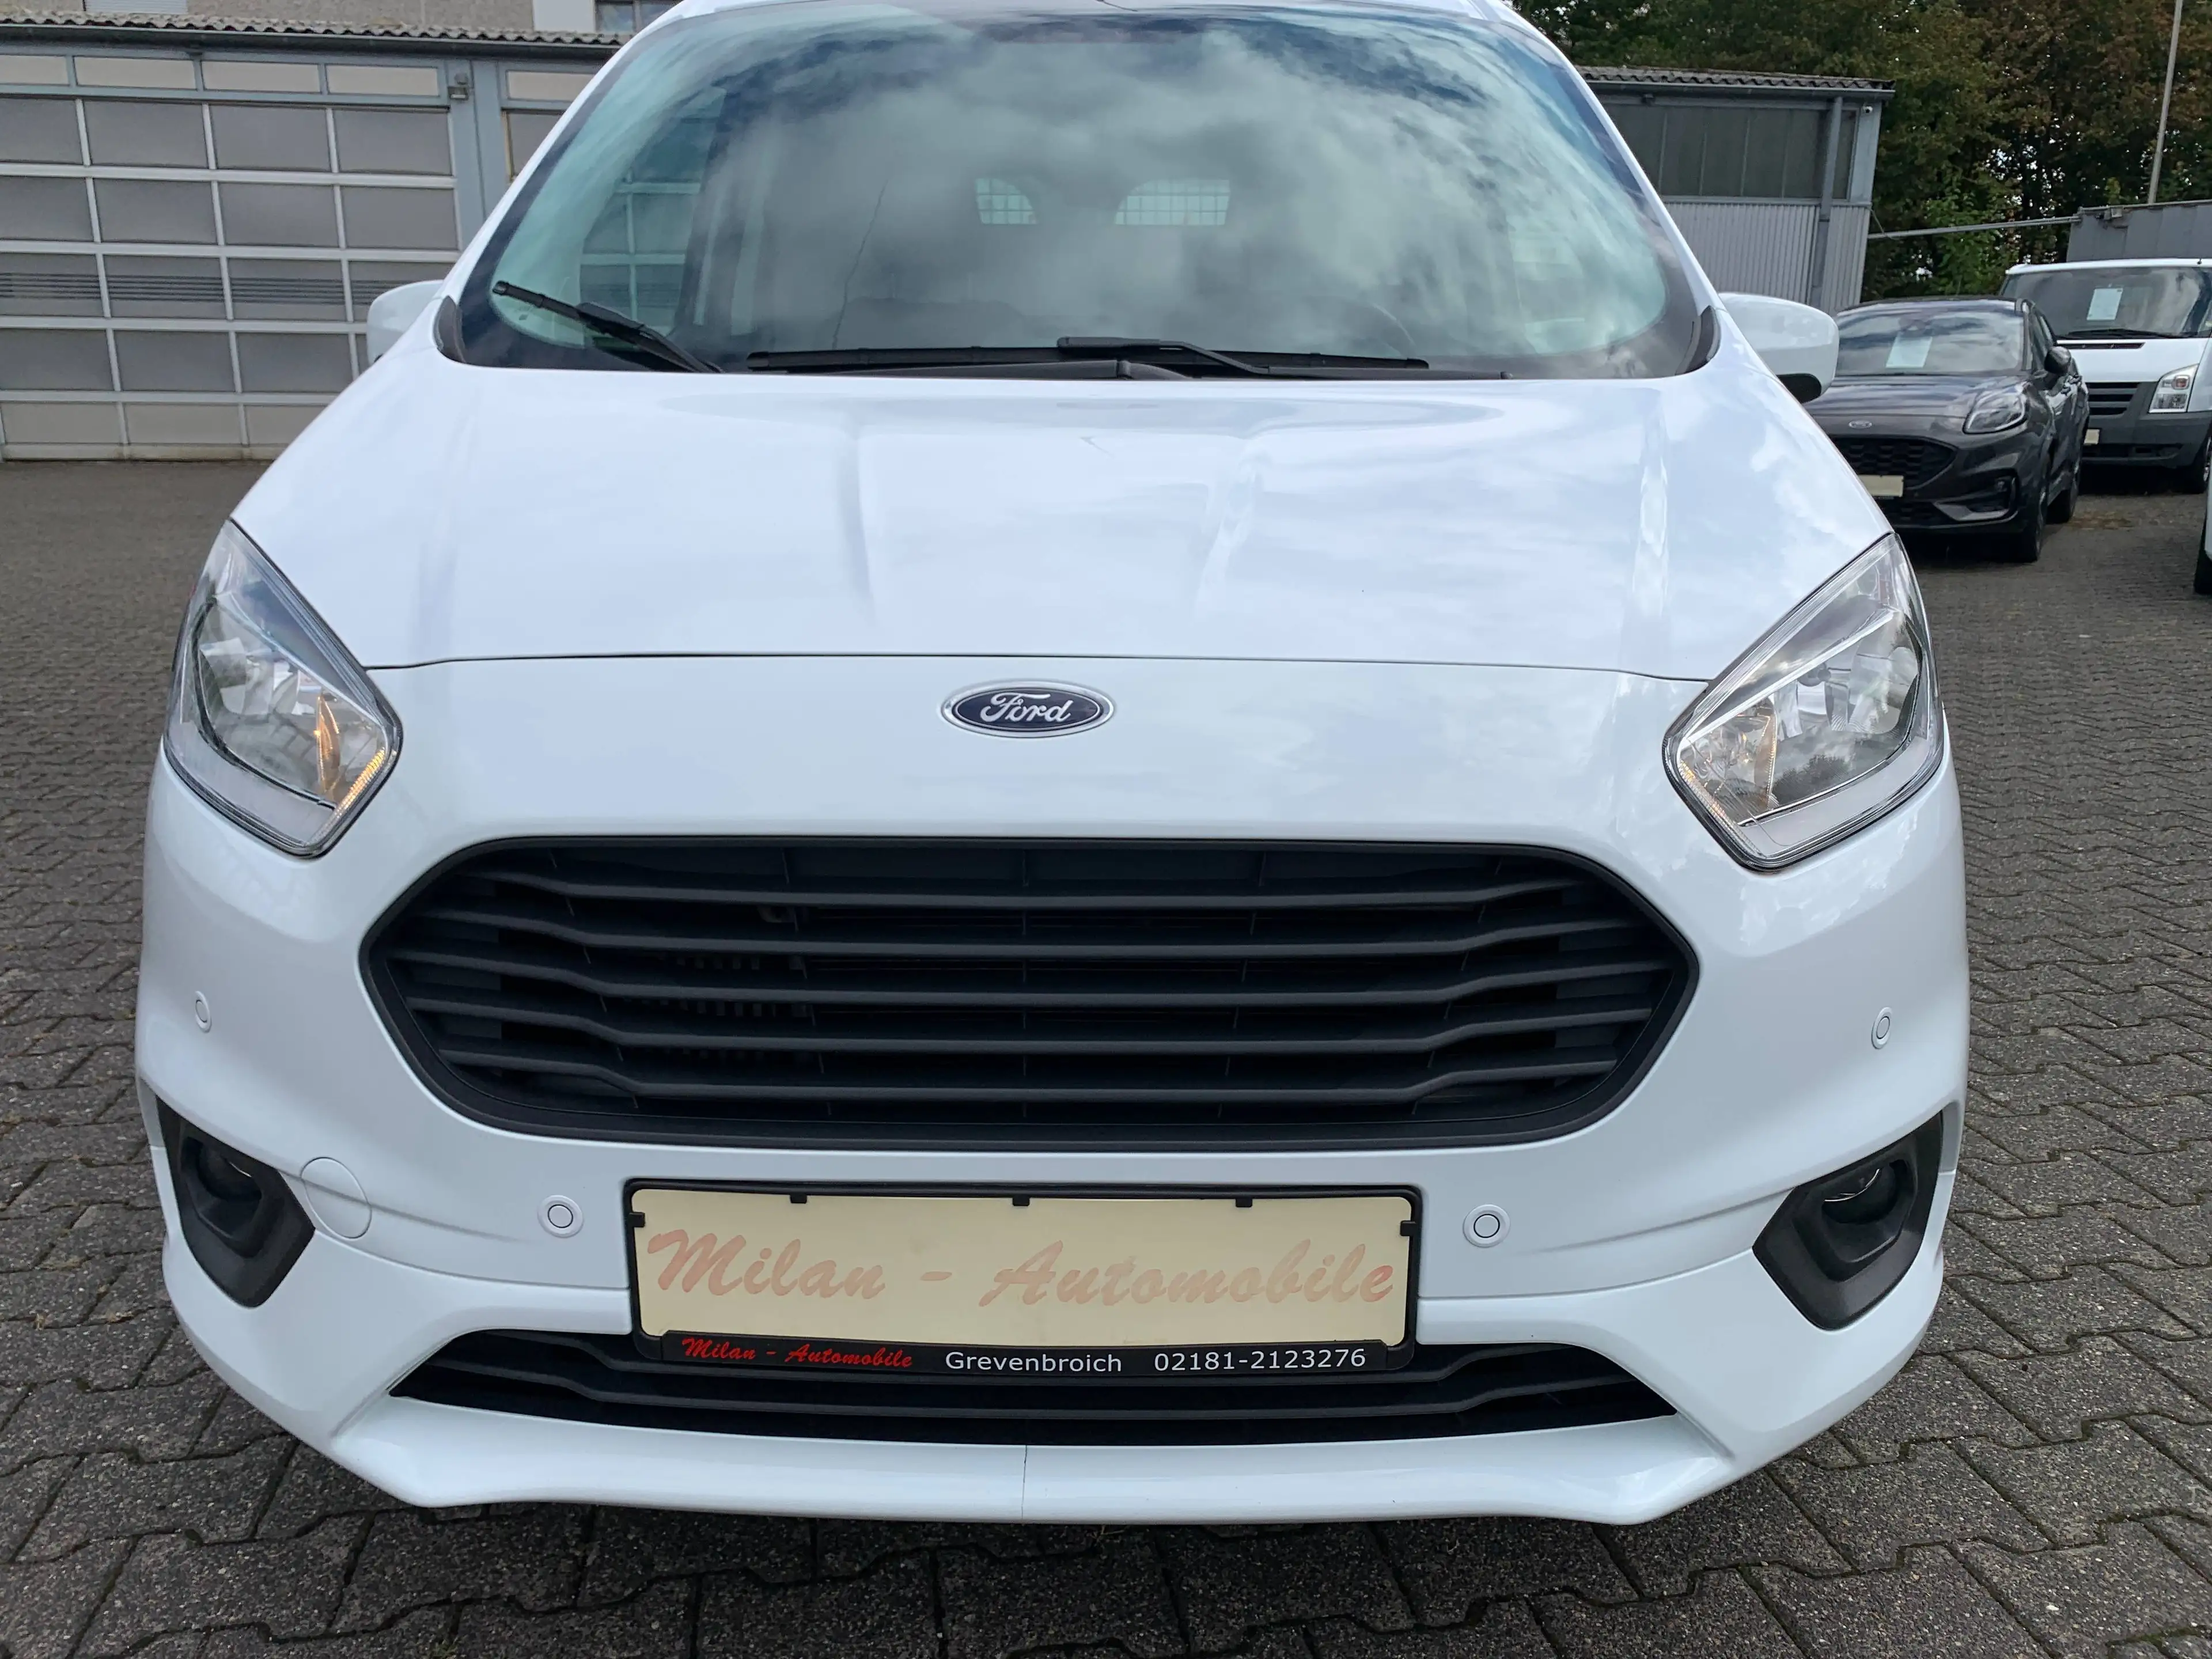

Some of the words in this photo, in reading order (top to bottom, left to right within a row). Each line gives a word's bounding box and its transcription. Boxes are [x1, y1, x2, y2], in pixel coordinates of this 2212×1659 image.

[980, 692, 1074, 722] Ford
[647, 1229, 886, 1300] Milan
[979, 1238, 1393, 1307] Automobile
[682, 1338, 756, 1360] Milan
[784, 1343, 913, 1368] Automobile
[945, 1351, 1122, 1372] Grevenbroich
[1154, 1348, 1366, 1371] 02181-2123276
